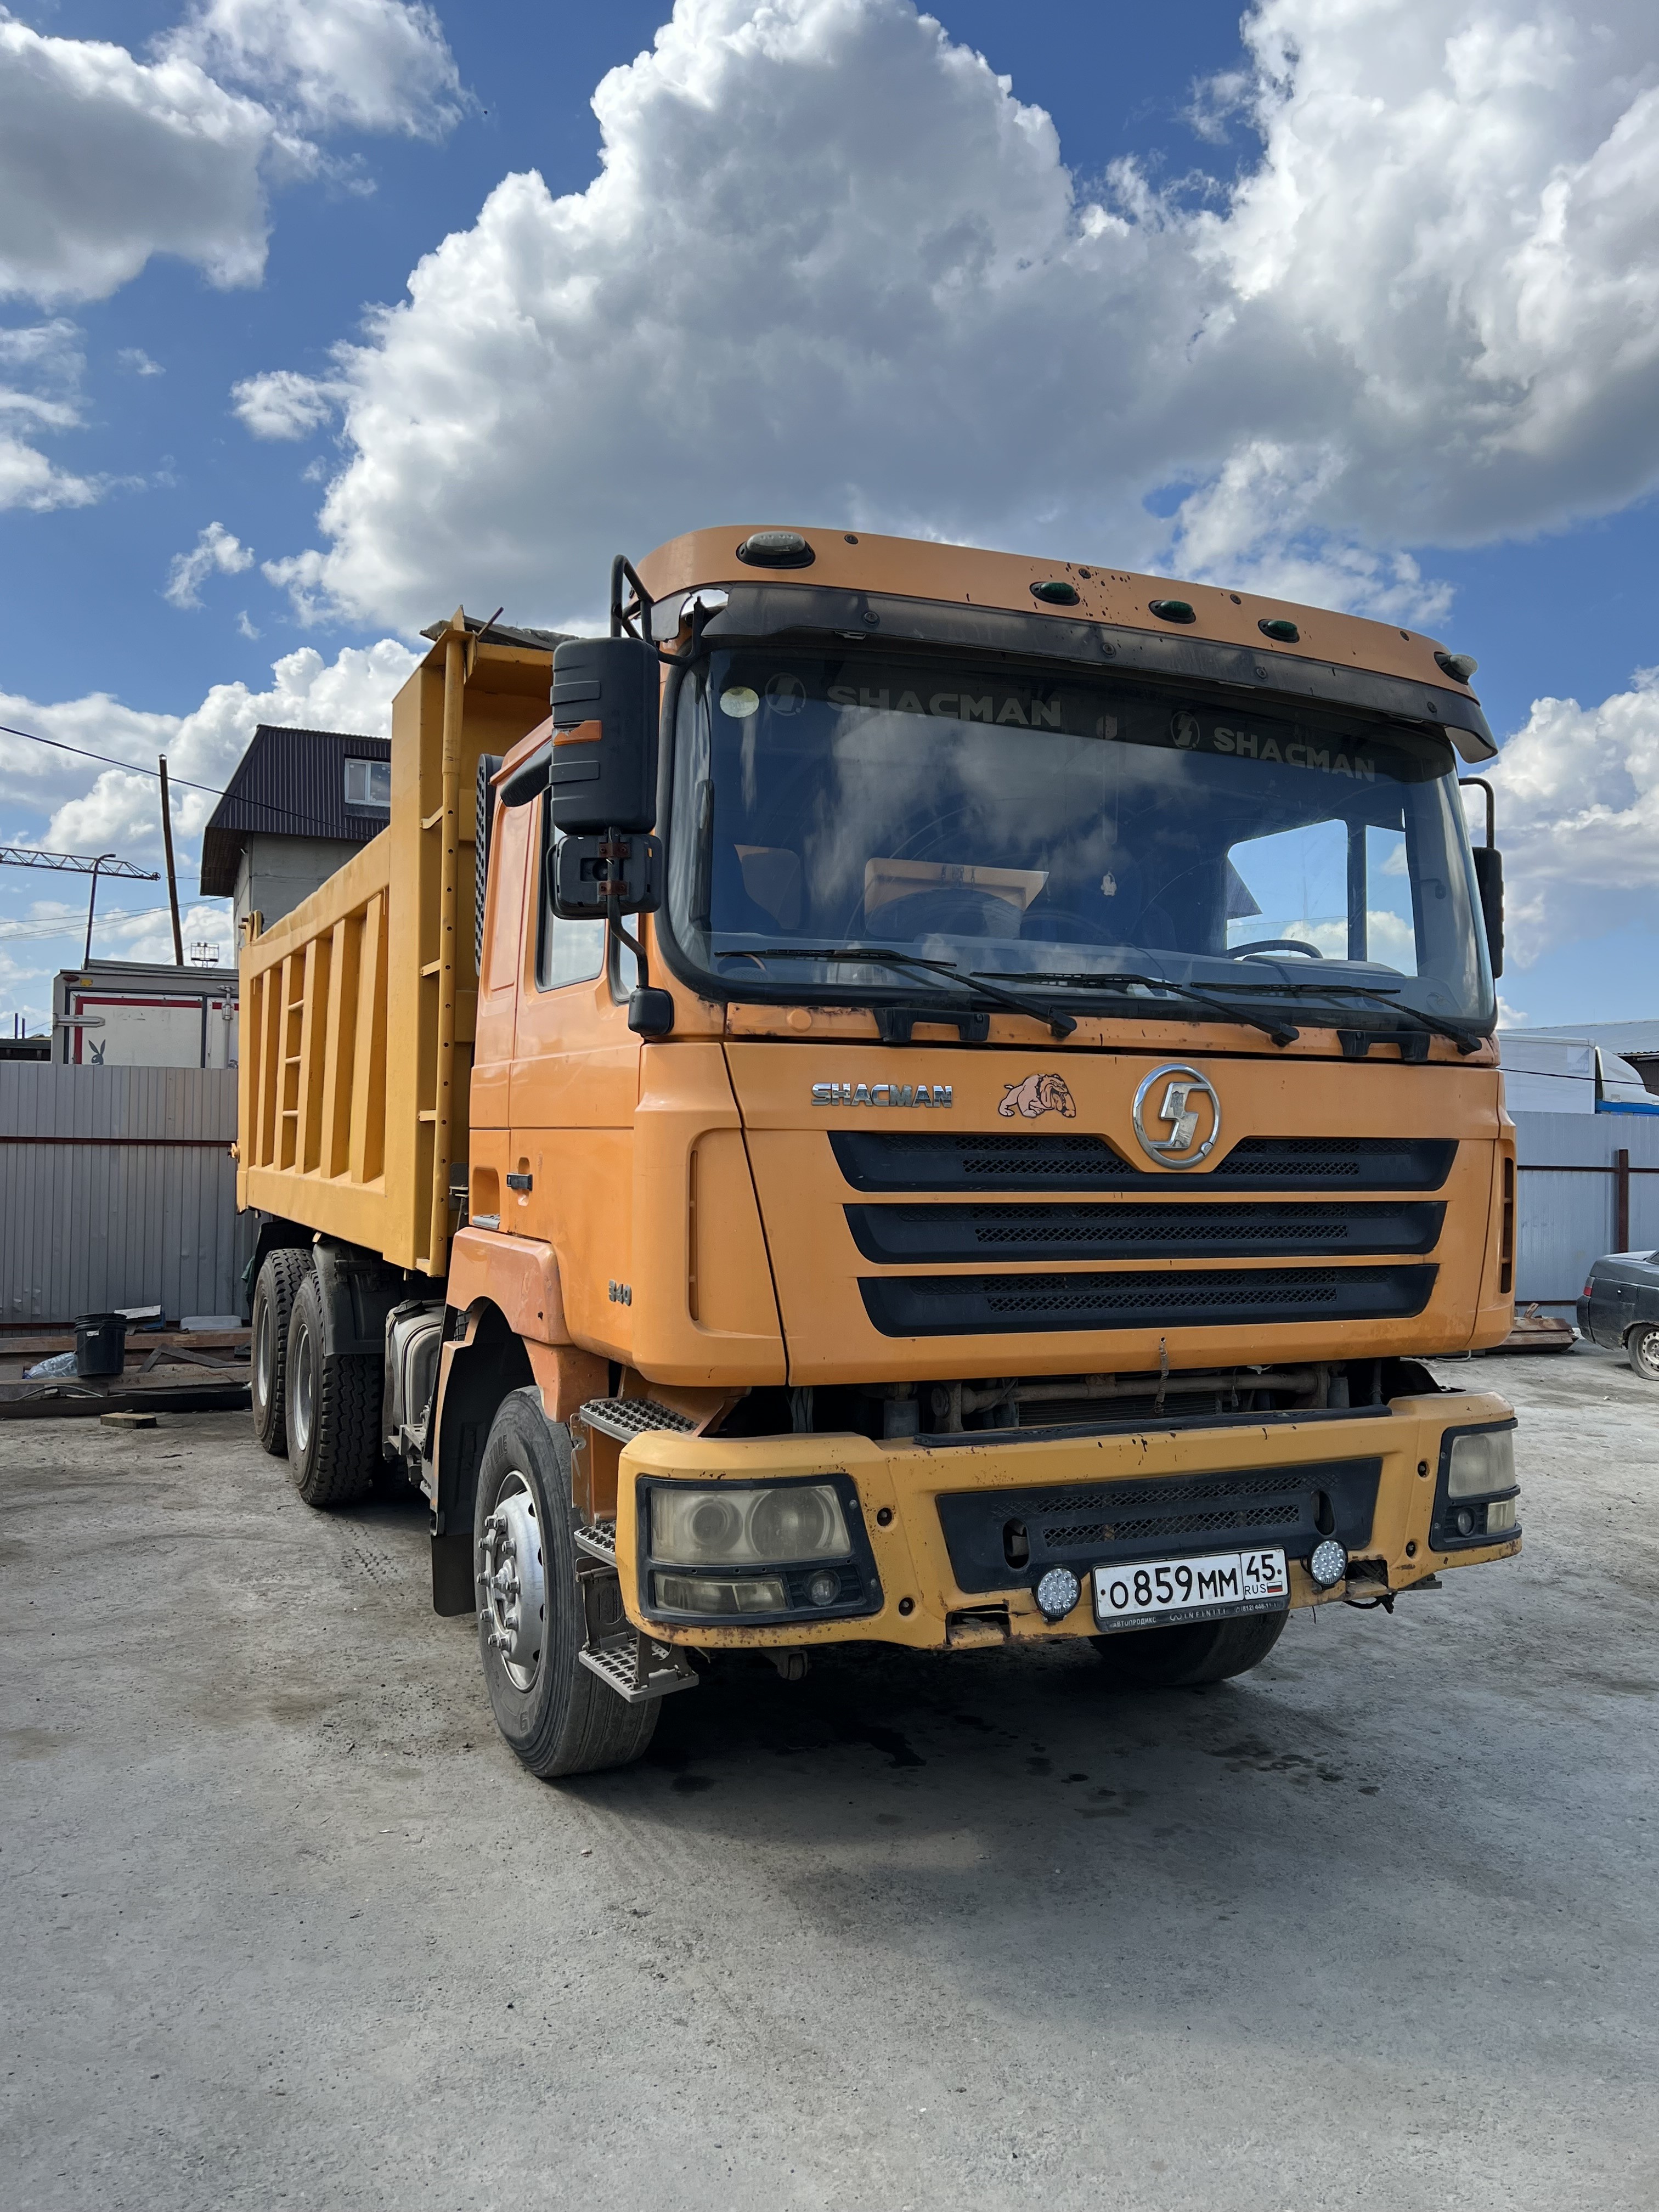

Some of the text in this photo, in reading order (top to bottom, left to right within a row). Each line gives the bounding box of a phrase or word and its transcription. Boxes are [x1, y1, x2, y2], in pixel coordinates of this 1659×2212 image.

[827, 686, 1061, 727] SHACMAN
[1213, 727, 1375, 782] SHACMAN
[811, 1083, 952, 1108] SHACMAN
[608, 1279, 632, 1306] 340
[1246, 1554, 1276, 1582] 45
[1244, 1583, 1266, 1595] RUS
[1184, 1609, 1226, 1619] INFINITI
